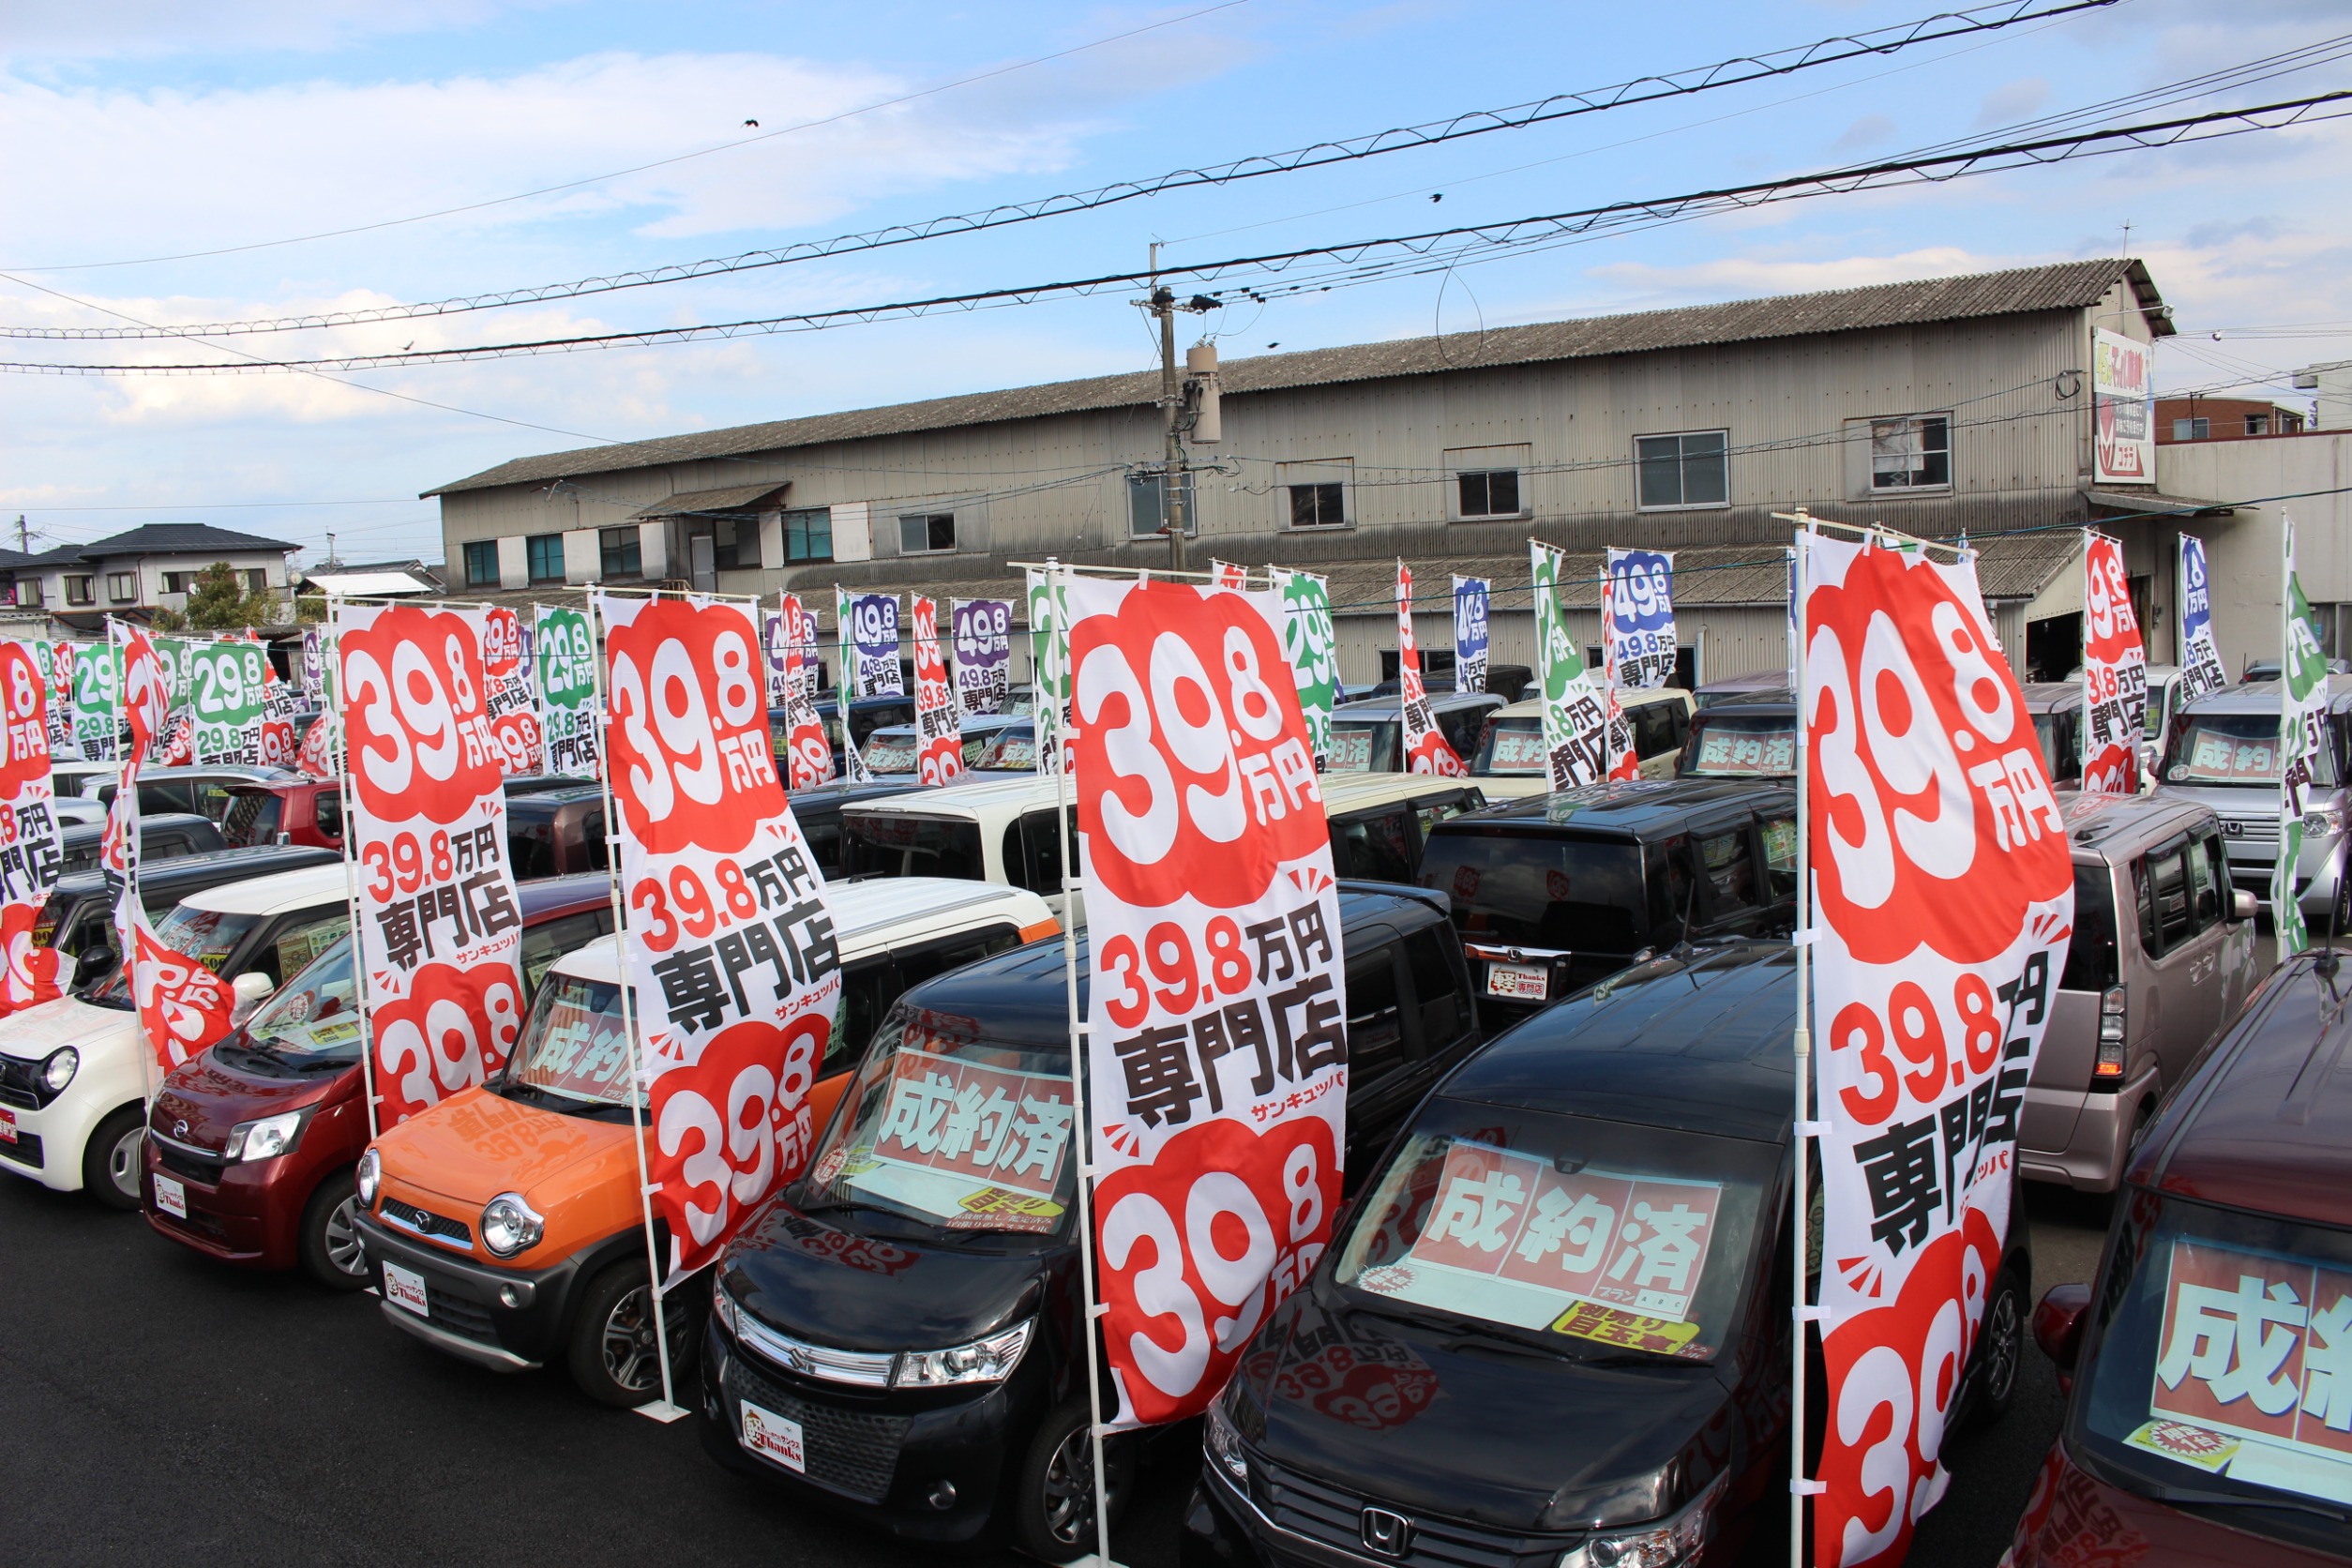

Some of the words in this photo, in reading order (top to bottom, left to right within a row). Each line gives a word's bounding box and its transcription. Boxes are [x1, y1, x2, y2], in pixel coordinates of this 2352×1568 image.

[2118, 446, 2133, 467] コチラ
[854, 603, 897, 647] 49.8万円
[957, 608, 1008, 656] 49.8万円
[1284, 594, 1334, 689] 29.8
[1617, 633, 1677, 659] 49.8万円
[194, 652, 264, 710] 29.8万円
[540, 623, 593, 694] 29.8万円
[959, 668, 1006, 690] 49.8万円
[1619, 653, 1675, 687] 専門店
[962, 685, 1006, 711] 専門店
[2087, 664, 2146, 704] 3.8万円
[0, 658, 49, 768] .8万円
[345, 634, 497, 794] 39.8万円
[547, 712, 591, 743] 29.8万円
[611, 630, 776, 823] 39.8万円
[2090, 692, 2146, 745] 専門店
[197, 727, 260, 752] 29.8万円
[550, 733, 597, 774] 専門店
[1078, 626, 1322, 865] 39.8万円
[1700, 737, 1793, 765] 成約済
[1807, 601, 2064, 910] 39.8万円
[2194, 741, 2280, 773] 成約
[0, 837, 61, 902] 門店
[362, 822, 500, 904] 39.8万円
[376, 868, 521, 972] 専門店
[631, 846, 816, 953] 39.8万円
[457, 930, 520, 965] サンキュッパ
[651, 898, 841, 1035] 専門店
[1100, 899, 1334, 1030] 39.8万円
[775, 974, 840, 1020] サンキュッパ
[1493, 971, 1515, 991] 軽
[1517, 972, 1545, 982] Thanks
[1517, 983, 1544, 994] 専門店
[380, 982, 521, 1124] 39.8
[531, 1021, 643, 1090] 成約
[1113, 972, 1349, 1130] 専門店
[1251, 1071, 1346, 1123] サンキュッパ
[658, 1033, 816, 1248] 39.8万円
[879, 1071, 1074, 1181] 成約済
[1425, 1170, 1707, 1291] 成約済
[399, 1287, 427, 1307] Thanks
[1598, 1286, 1636, 1304] プラン
[1562, 1315, 1677, 1352] 目玉車
[755, 1431, 802, 1464] Thanks
[780, 1435, 800, 1450] サンクス
